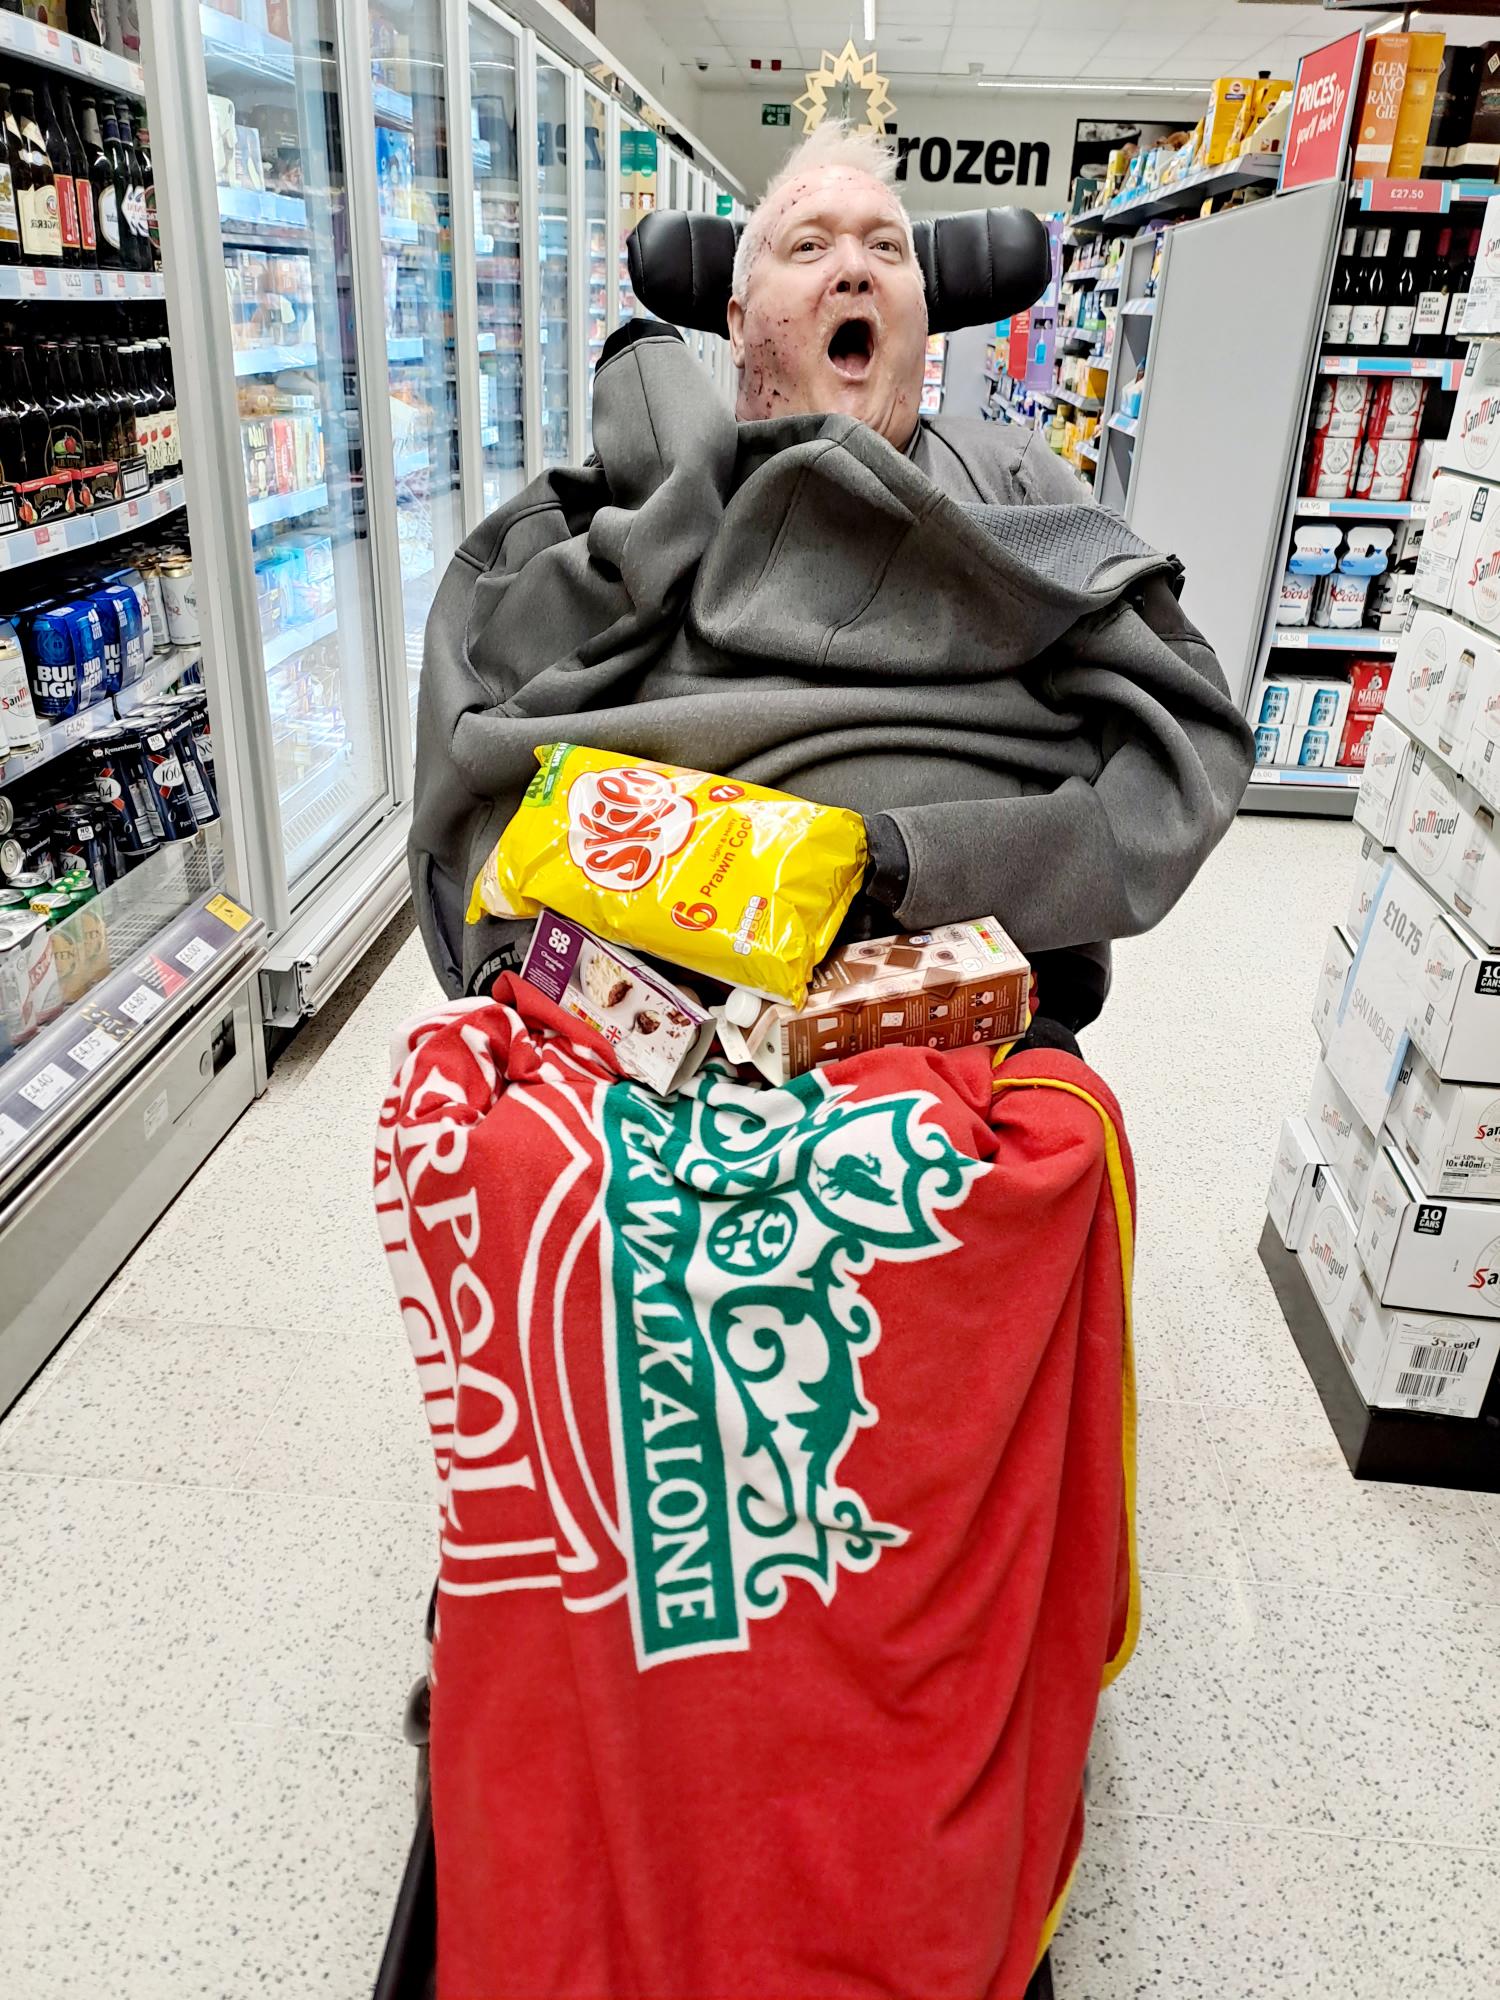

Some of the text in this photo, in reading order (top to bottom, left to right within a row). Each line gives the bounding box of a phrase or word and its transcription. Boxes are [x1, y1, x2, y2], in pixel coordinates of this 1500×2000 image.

[1372, 61, 1407, 77] GLEN
[1297, 72, 1337, 114] PRICES
[1381, 76, 1406, 91] MO
[1367, 90, 1396, 104] RAN
[1375, 104, 1399, 119] GIE
[1390, 189, 1424, 200] £27.50
[1412, 504, 1430, 513] £4.9
[33, 679, 77, 699] LIGH
[161, 763, 181, 783] 166
[700, 850, 737, 898] Prawn
[670, 901, 718, 932] 6
[1382, 899, 1424, 957] £10.75
[1352, 987, 1396, 1056] SAN MIGUEL
[72, 1036, 101, 1061] £4.75
[24, 1073, 54, 1100] £4.40
[1418, 1218, 1441, 1230] CANS
[1420, 1207, 1443, 1221] 10
[639, 1388, 718, 1629] ALONE
